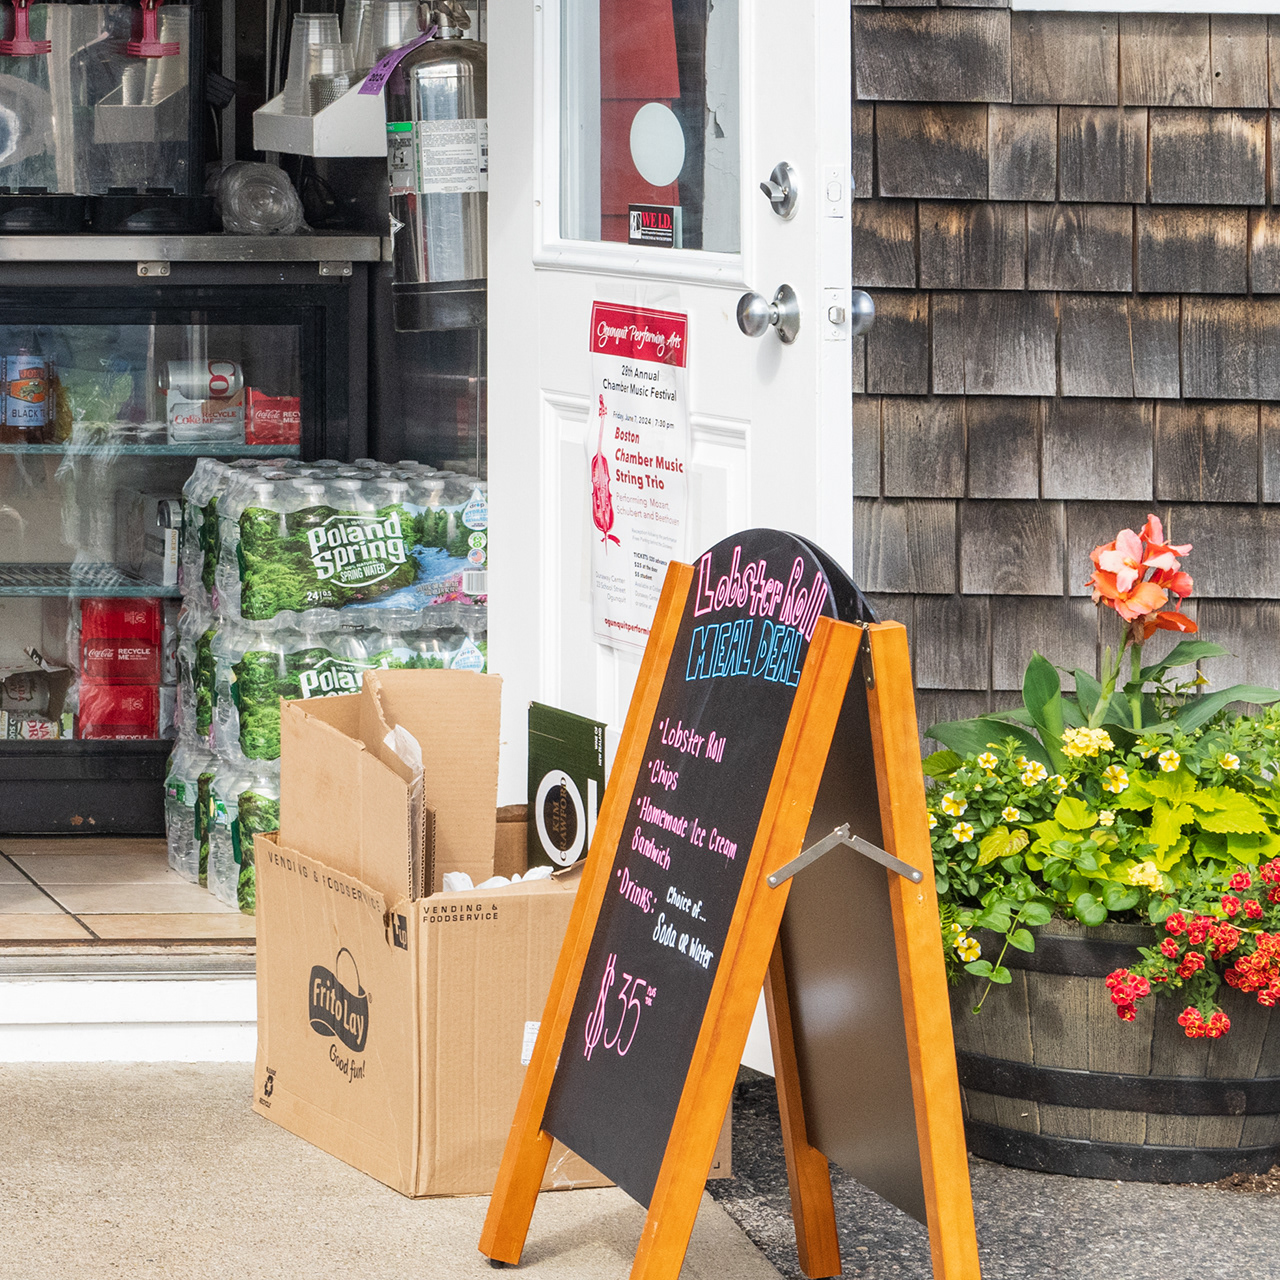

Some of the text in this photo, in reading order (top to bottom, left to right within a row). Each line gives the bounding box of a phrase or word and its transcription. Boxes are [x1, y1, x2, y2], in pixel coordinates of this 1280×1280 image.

[642, 212, 656, 227] WE
[597, 321, 681, 356] Ogunquit Performing Arts
[603, 379, 676, 401] Chamber Music Festival
[634, 368, 659, 381] Annual
[615, 427, 640, 444] Boston
[615, 448, 683, 473] Chamber Music
[616, 469, 664, 489] String Trio
[306, 511, 403, 557] Poland
[309, 539, 407, 579] Spring
[341, 563, 386, 582] SPRING WATER
[307, 591, 319, 600] 24
[694, 546, 828, 642] Lobster Roll
[686, 620, 802, 687] MEAL DEAL
[661, 717, 726, 762] Lobster Roll
[650, 759, 679, 791] Chips
[639, 796, 737, 860] Homemade Ice Cream
[631, 826, 671, 870] Sandwich
[268, 851, 381, 912] VENDING & FOODSERVICE
[423, 903, 498, 914] VENDING &
[666, 886, 691, 913] Choice
[423, 912, 499, 923] FOODSERVICE
[399, 929, 407, 947] up
[652, 912, 677, 948] Soda
[689, 938, 714, 969] Water
[313, 978, 343, 1020] Frito
[584, 953, 647, 1061] $35
[329, 1044, 366, 1083] Good fun!
